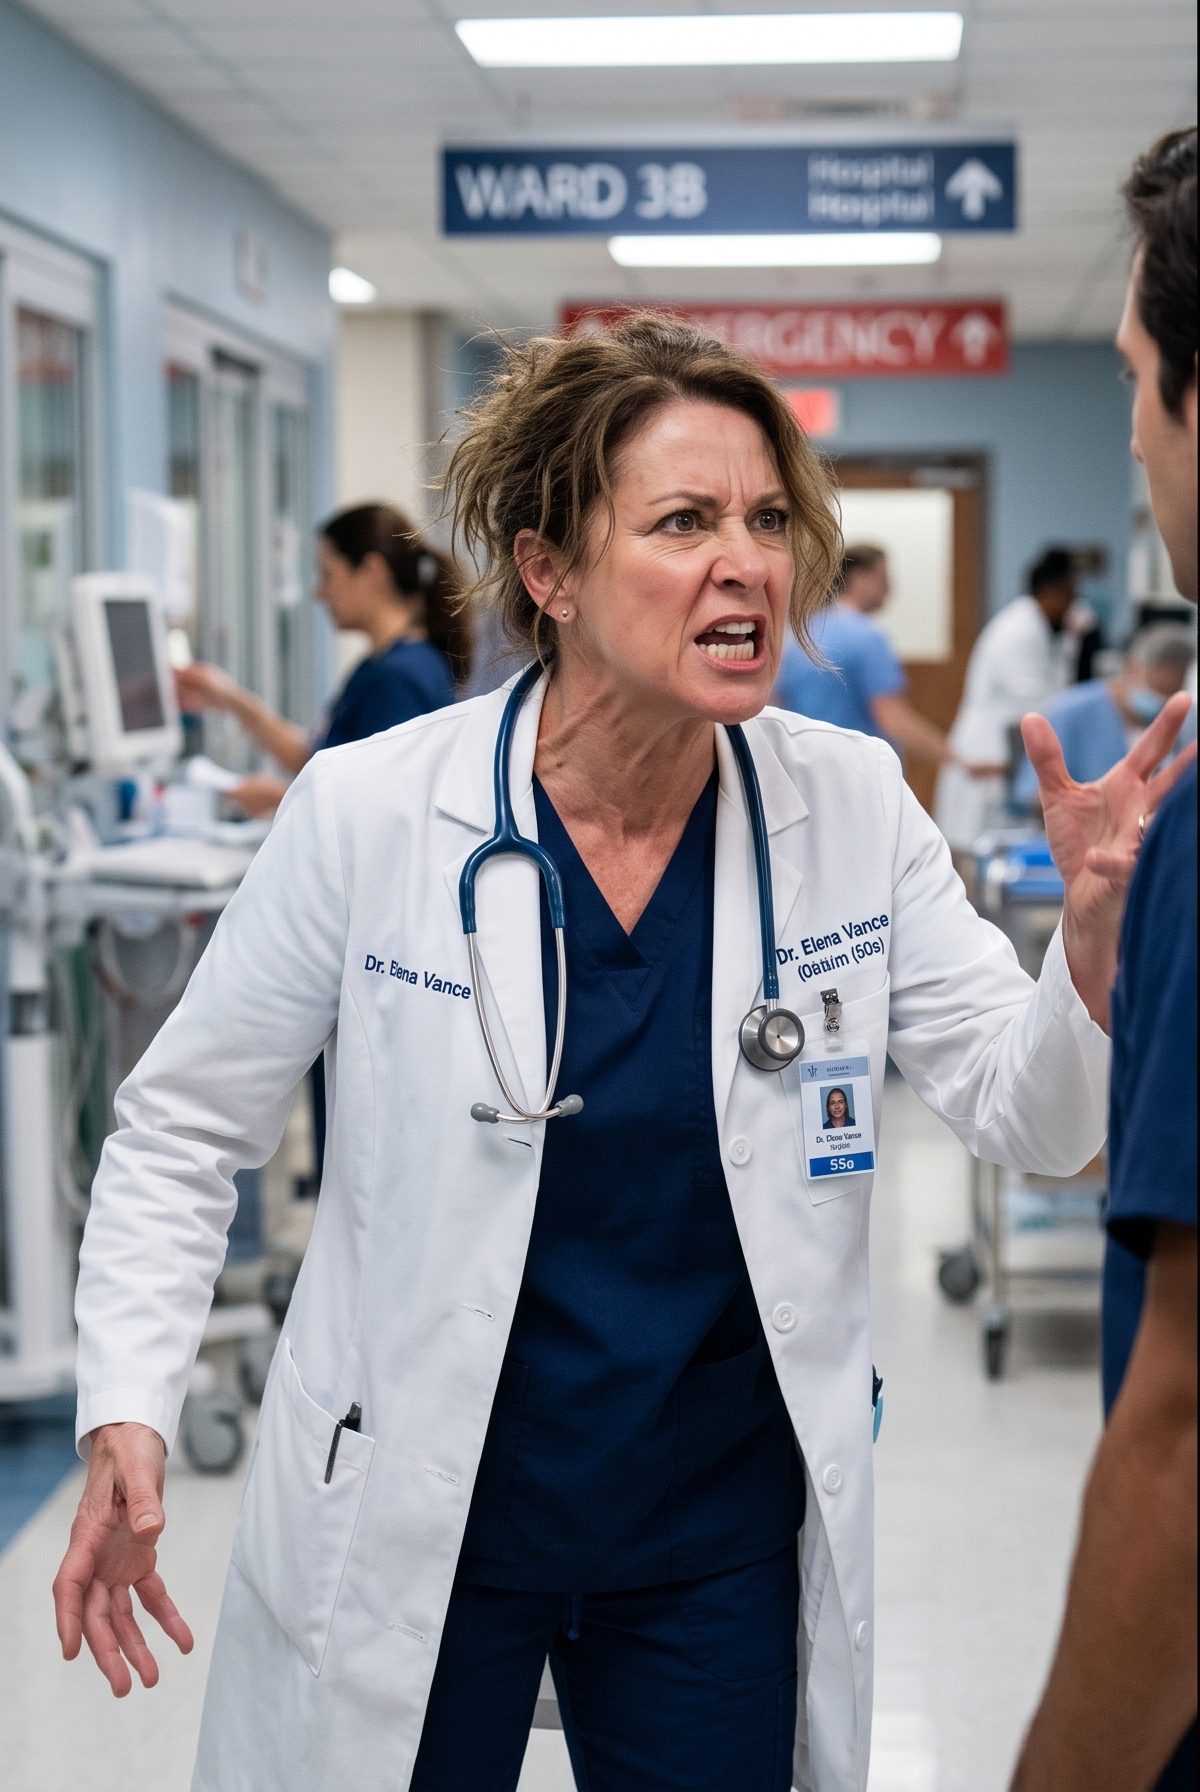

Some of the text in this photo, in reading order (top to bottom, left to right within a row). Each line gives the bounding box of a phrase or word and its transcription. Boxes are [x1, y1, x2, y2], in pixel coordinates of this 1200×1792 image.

[454, 162, 708, 220] WARD 3B
[776, 914, 890, 966] Dr. Elena Vance
[364, 954, 385, 974] Dr.
[423, 970, 472, 1000] Vance
